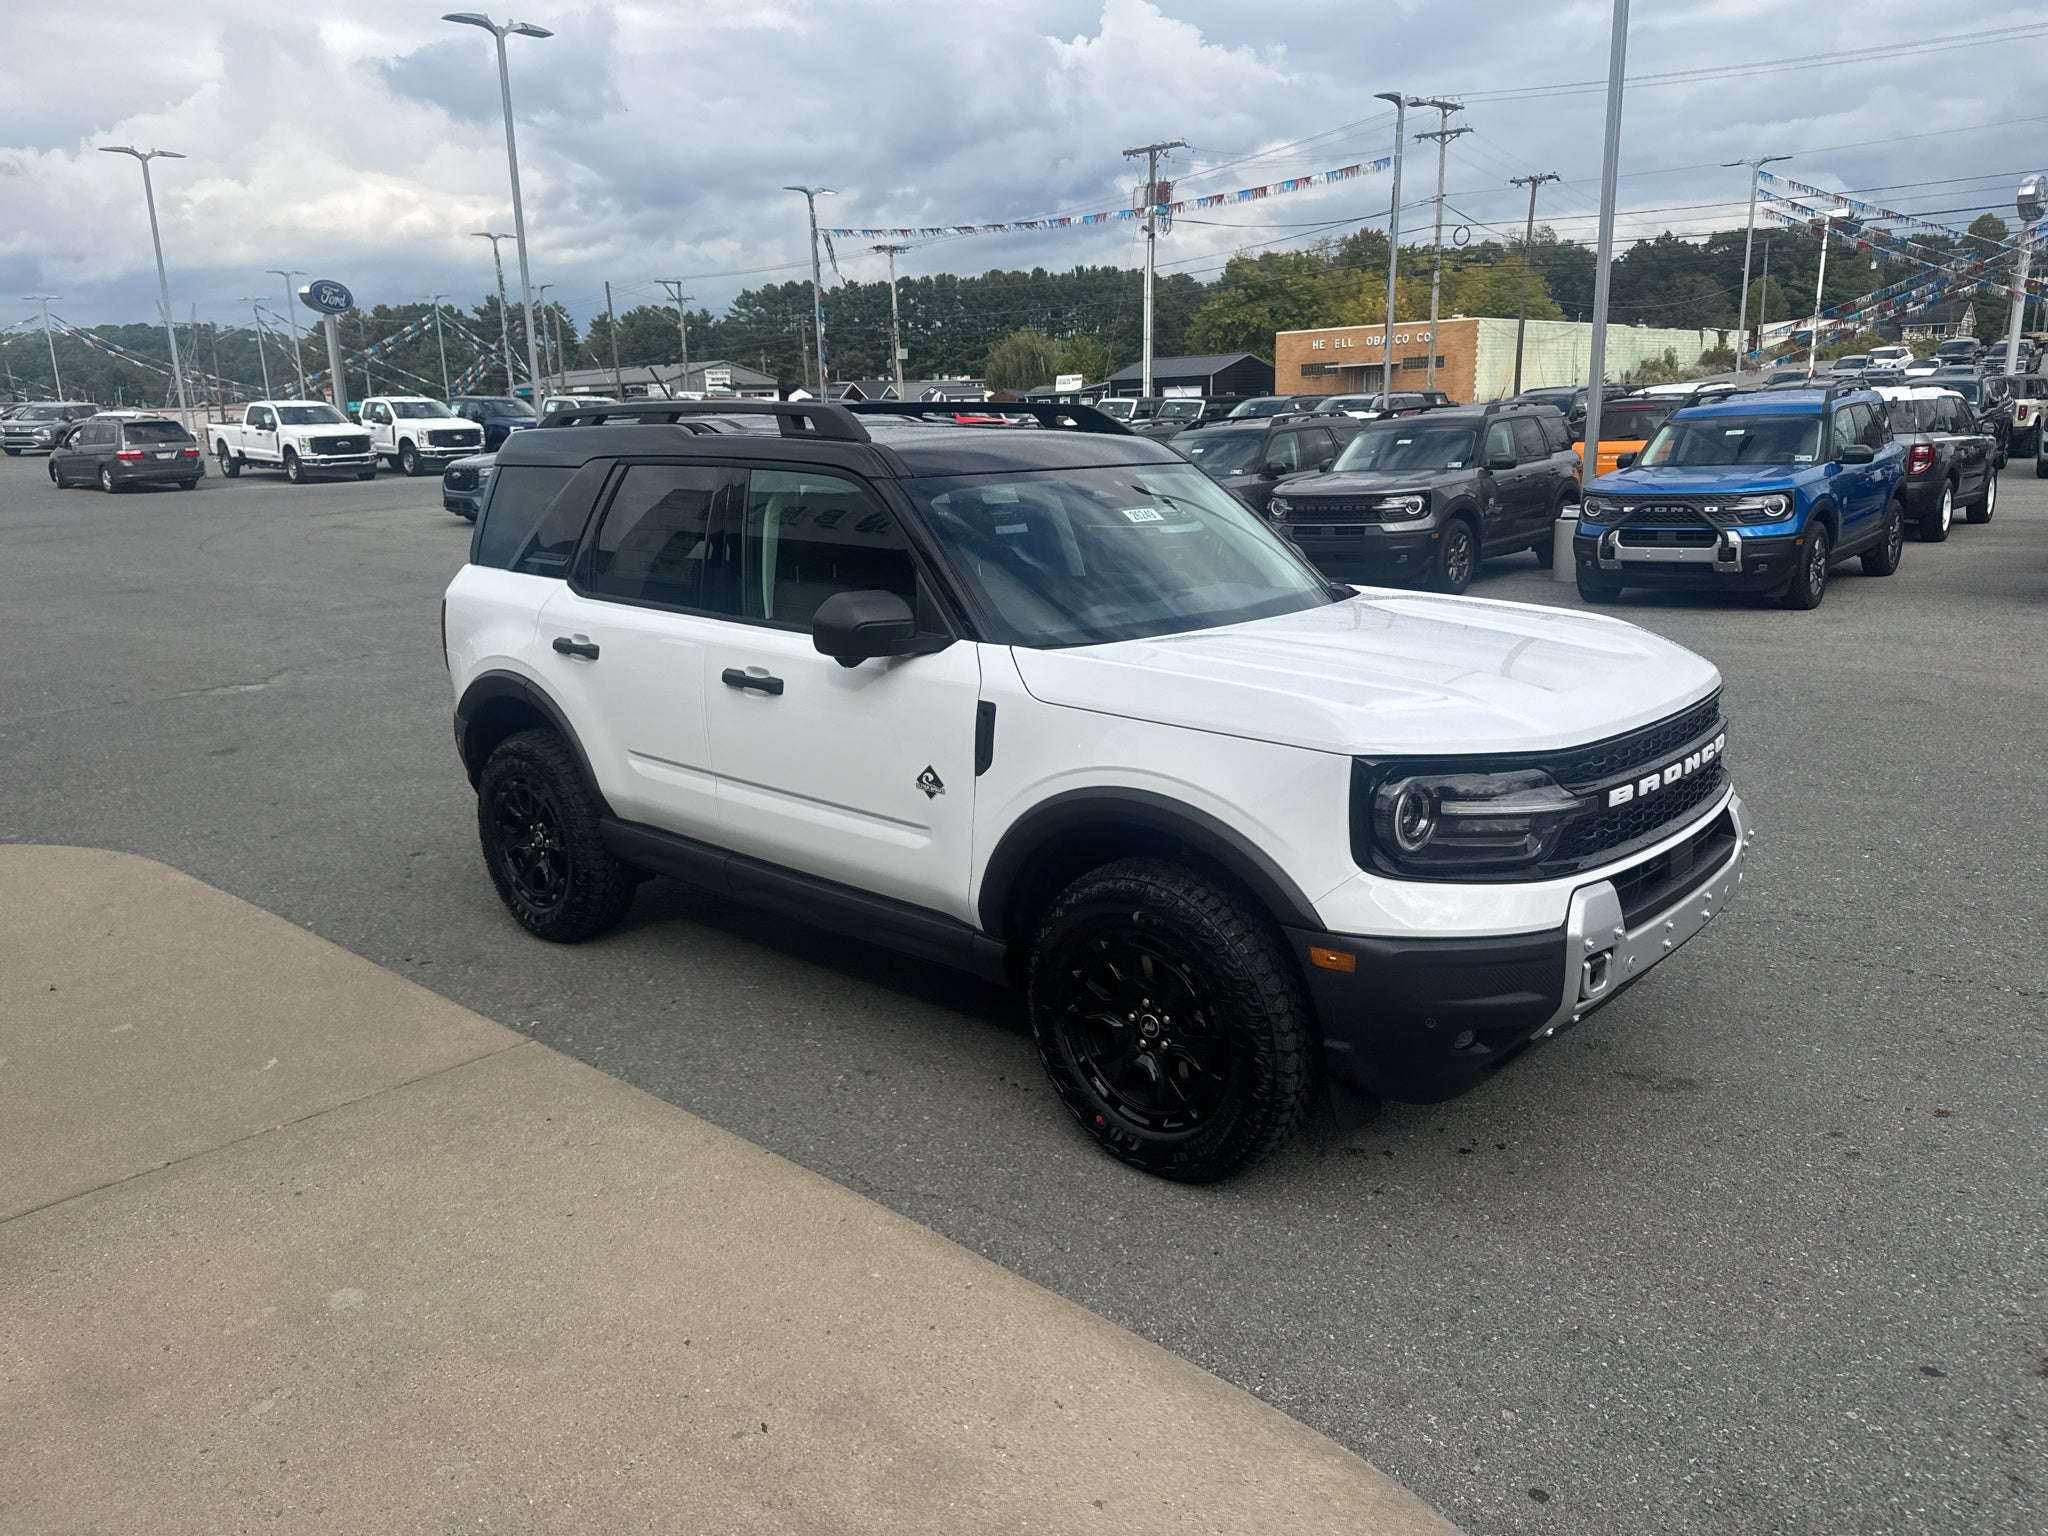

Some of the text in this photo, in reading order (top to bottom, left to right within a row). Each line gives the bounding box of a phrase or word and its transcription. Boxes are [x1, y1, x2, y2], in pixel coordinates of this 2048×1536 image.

[320, 285, 346, 307] Ford
[1416, 332, 1431, 343] CO
[1608, 732, 1725, 807] BRONCO
